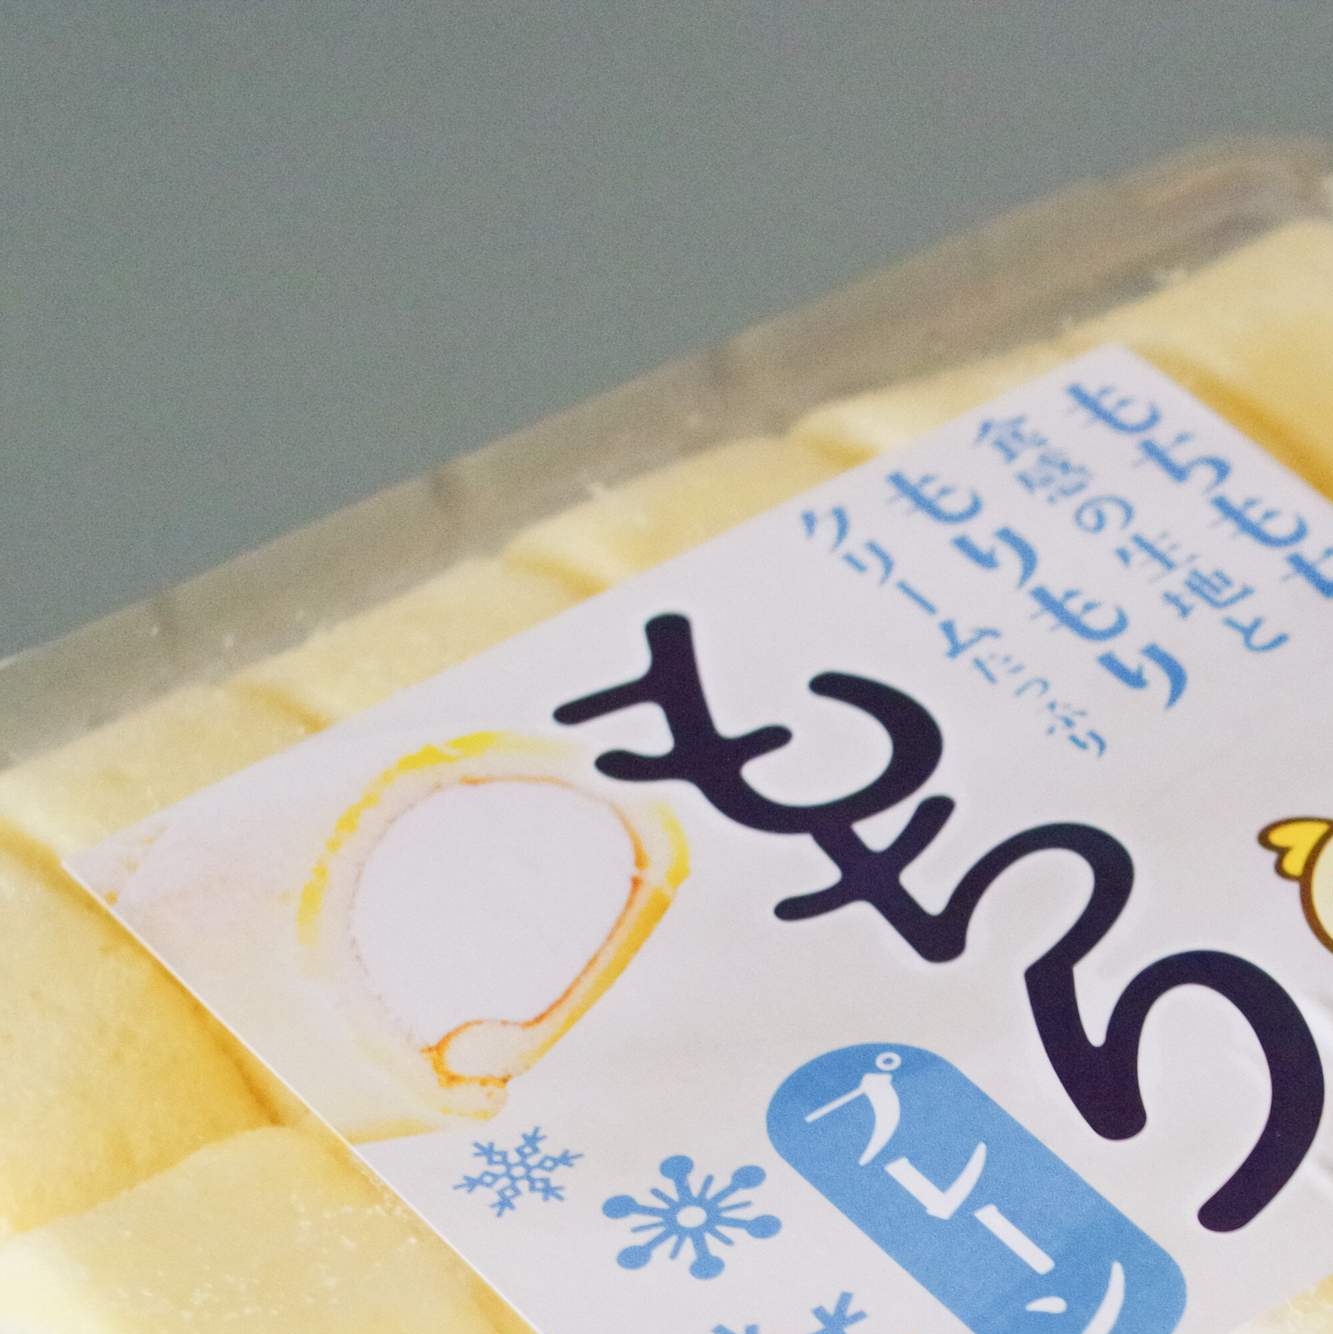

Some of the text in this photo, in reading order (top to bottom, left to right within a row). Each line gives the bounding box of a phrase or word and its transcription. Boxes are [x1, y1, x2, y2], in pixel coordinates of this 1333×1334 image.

[801, 505, 1106, 758] クリームたっぷり
[887, 471, 1188, 709] もりもり
[977, 416, 1289, 653] 食感の生地と
